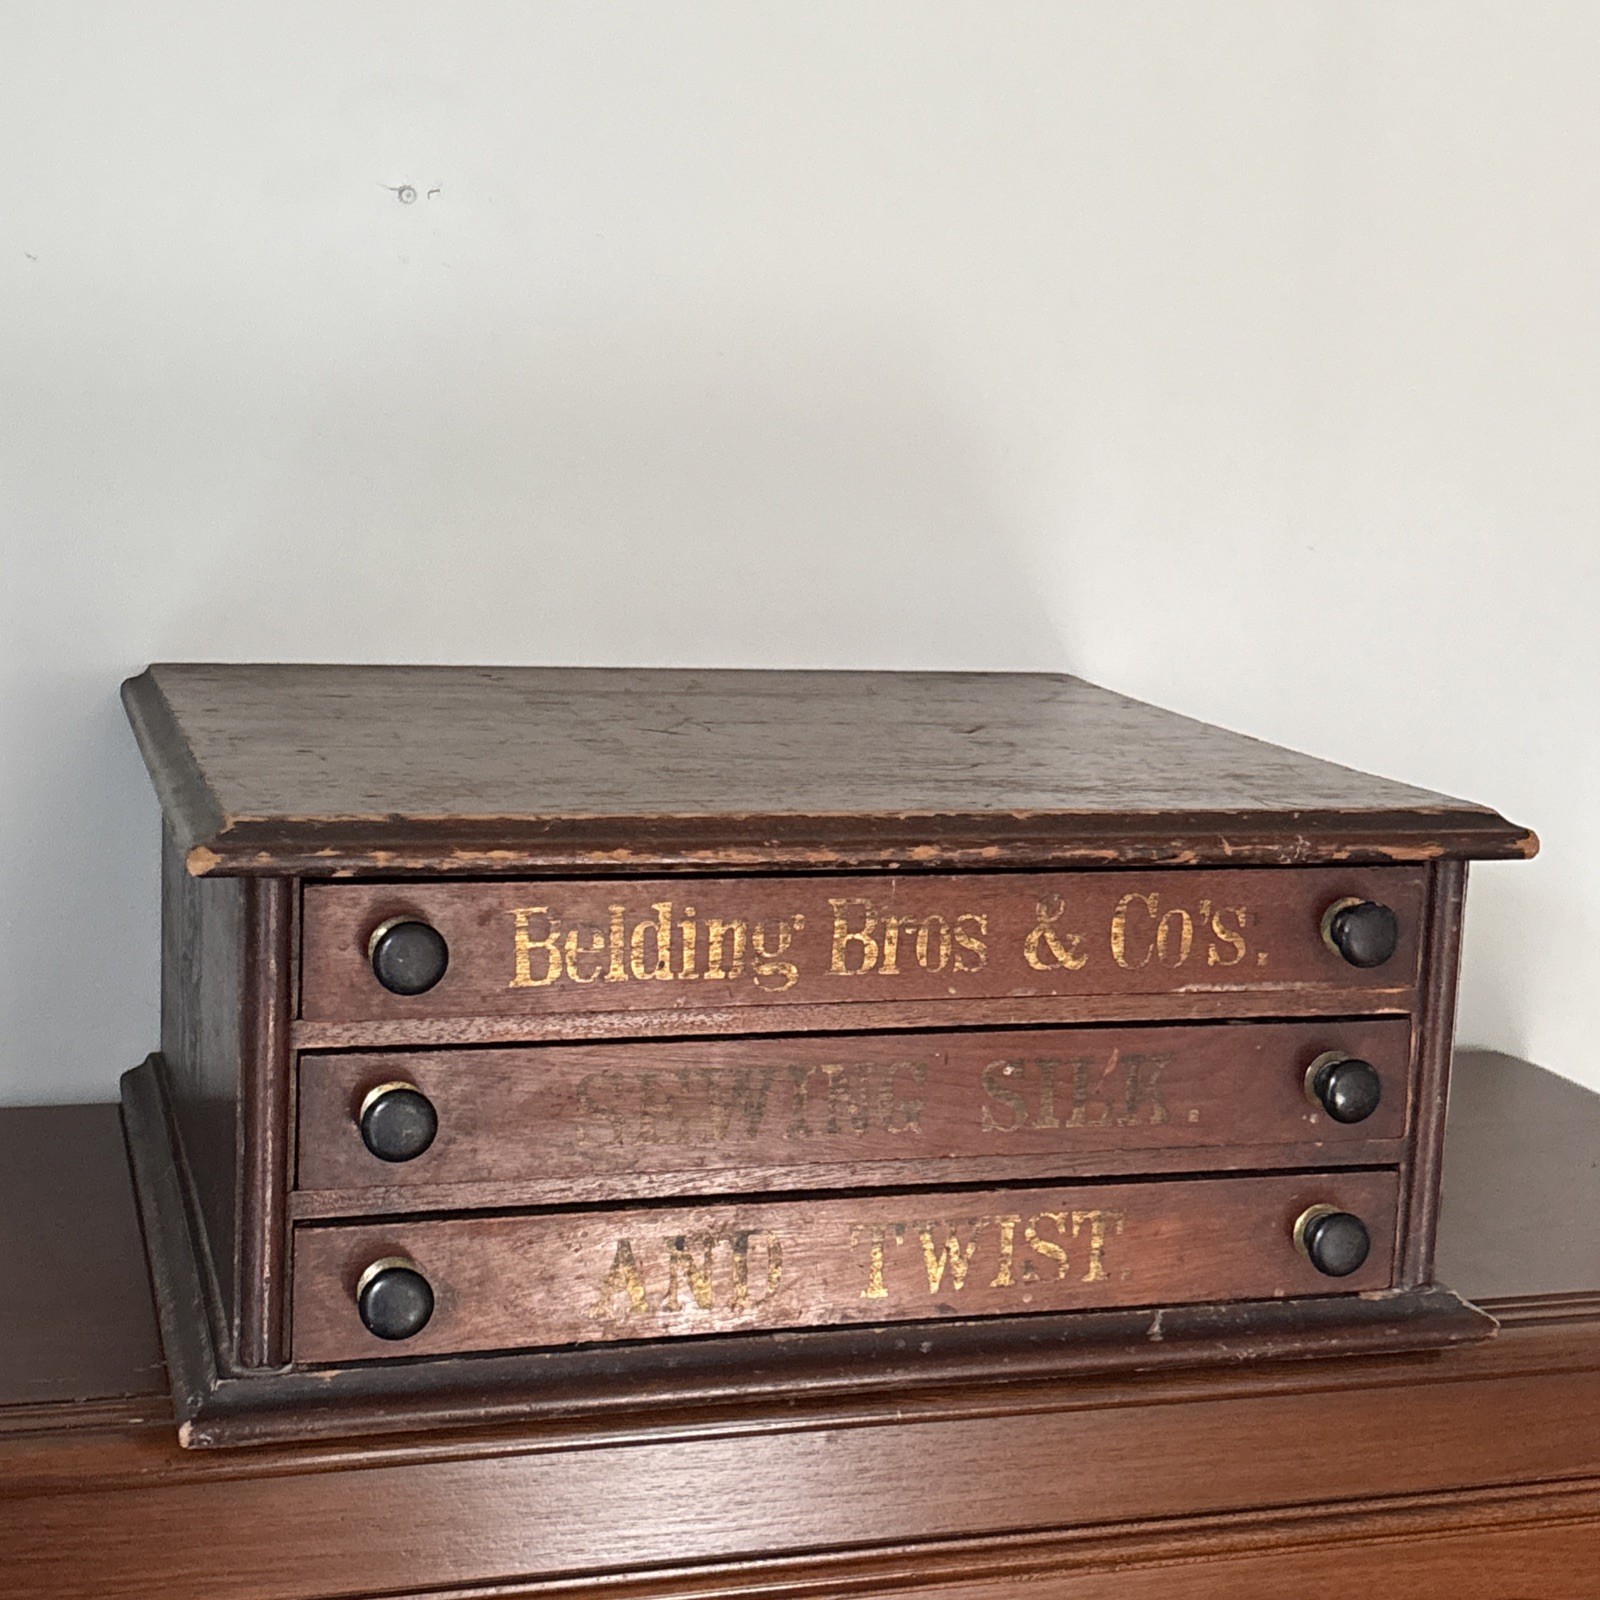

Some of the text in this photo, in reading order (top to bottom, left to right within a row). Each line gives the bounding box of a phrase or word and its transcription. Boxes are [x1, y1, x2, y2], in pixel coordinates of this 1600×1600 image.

[506, 892, 1269, 992] Belding Bros & Co's.
[579, 1228, 783, 1319] AND
